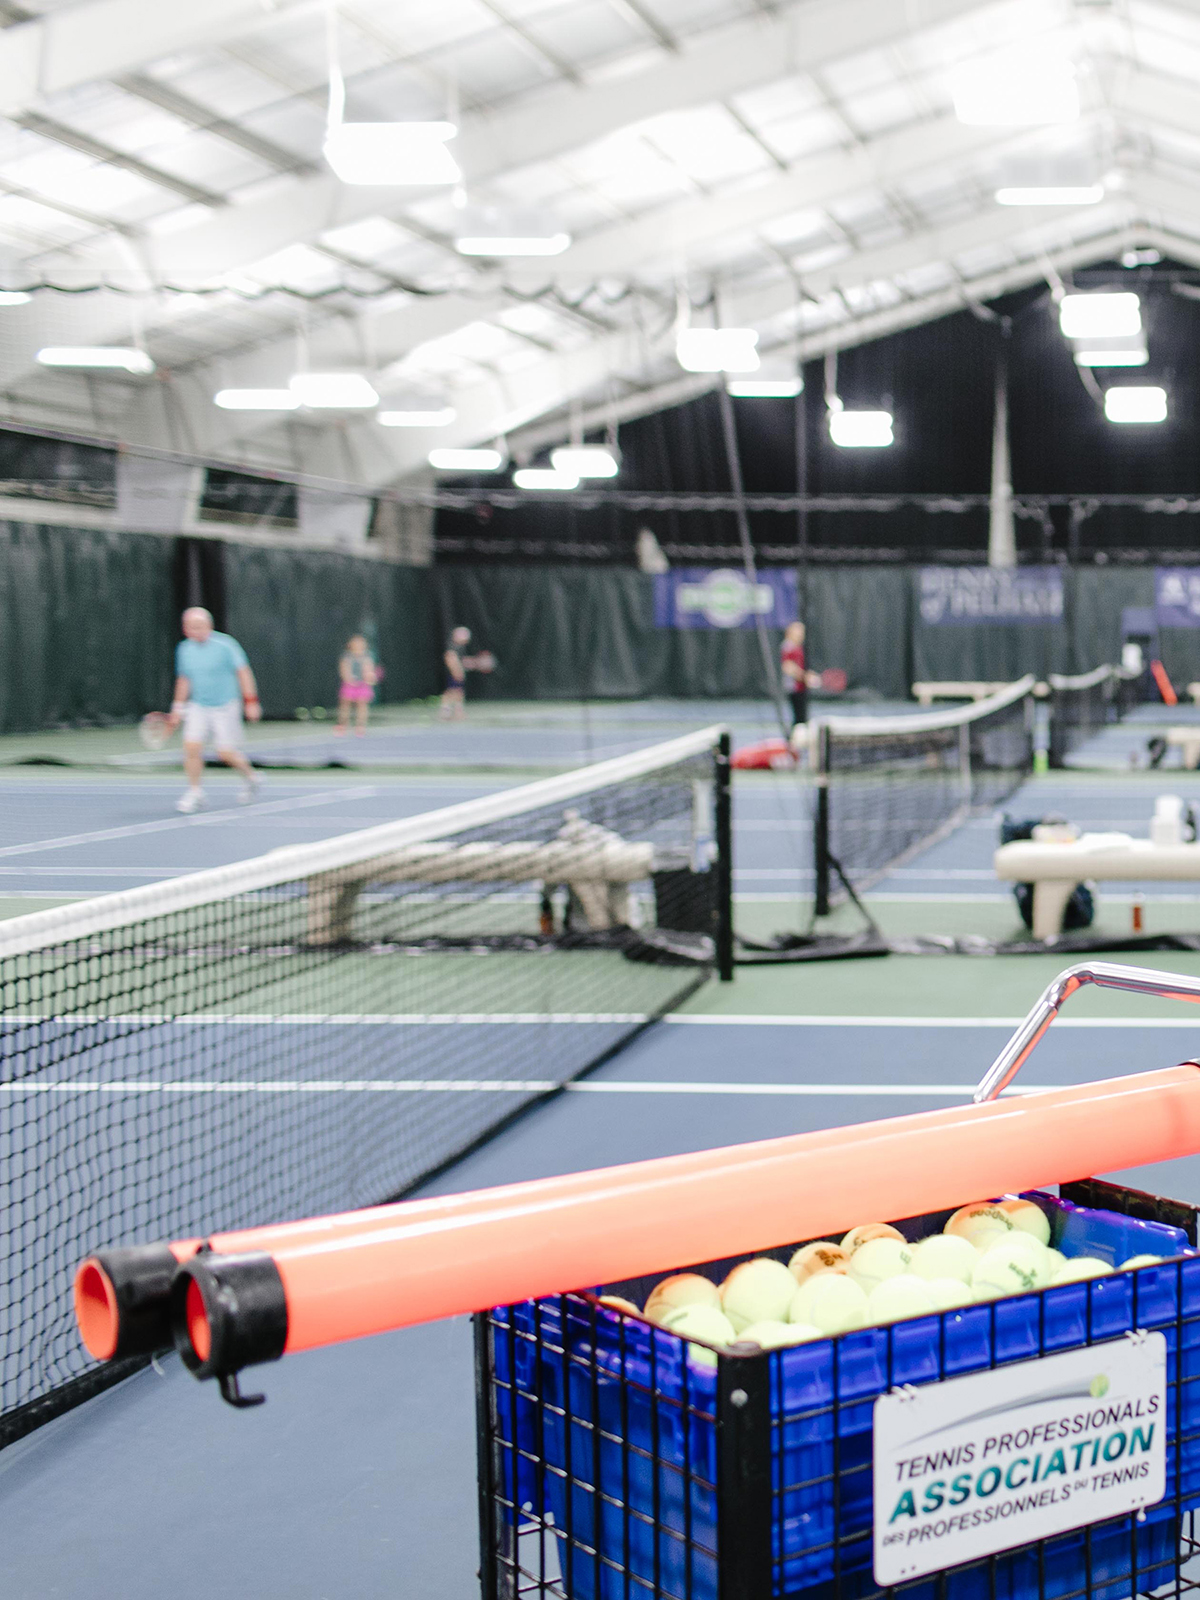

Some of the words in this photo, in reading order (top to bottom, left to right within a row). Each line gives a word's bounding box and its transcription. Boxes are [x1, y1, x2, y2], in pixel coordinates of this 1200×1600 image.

[887, 1423, 1156, 1525] ASSOCIATION
[896, 1443, 976, 1482] TENNIS
[982, 1395, 1160, 1459] PROFESSIONALS
[882, 1531, 906, 1548] DES
[906, 1484, 1072, 1546] PROFESSIONNELS
[1074, 1478, 1089, 1491] DU
[1091, 1462, 1150, 1493] TENNIS
